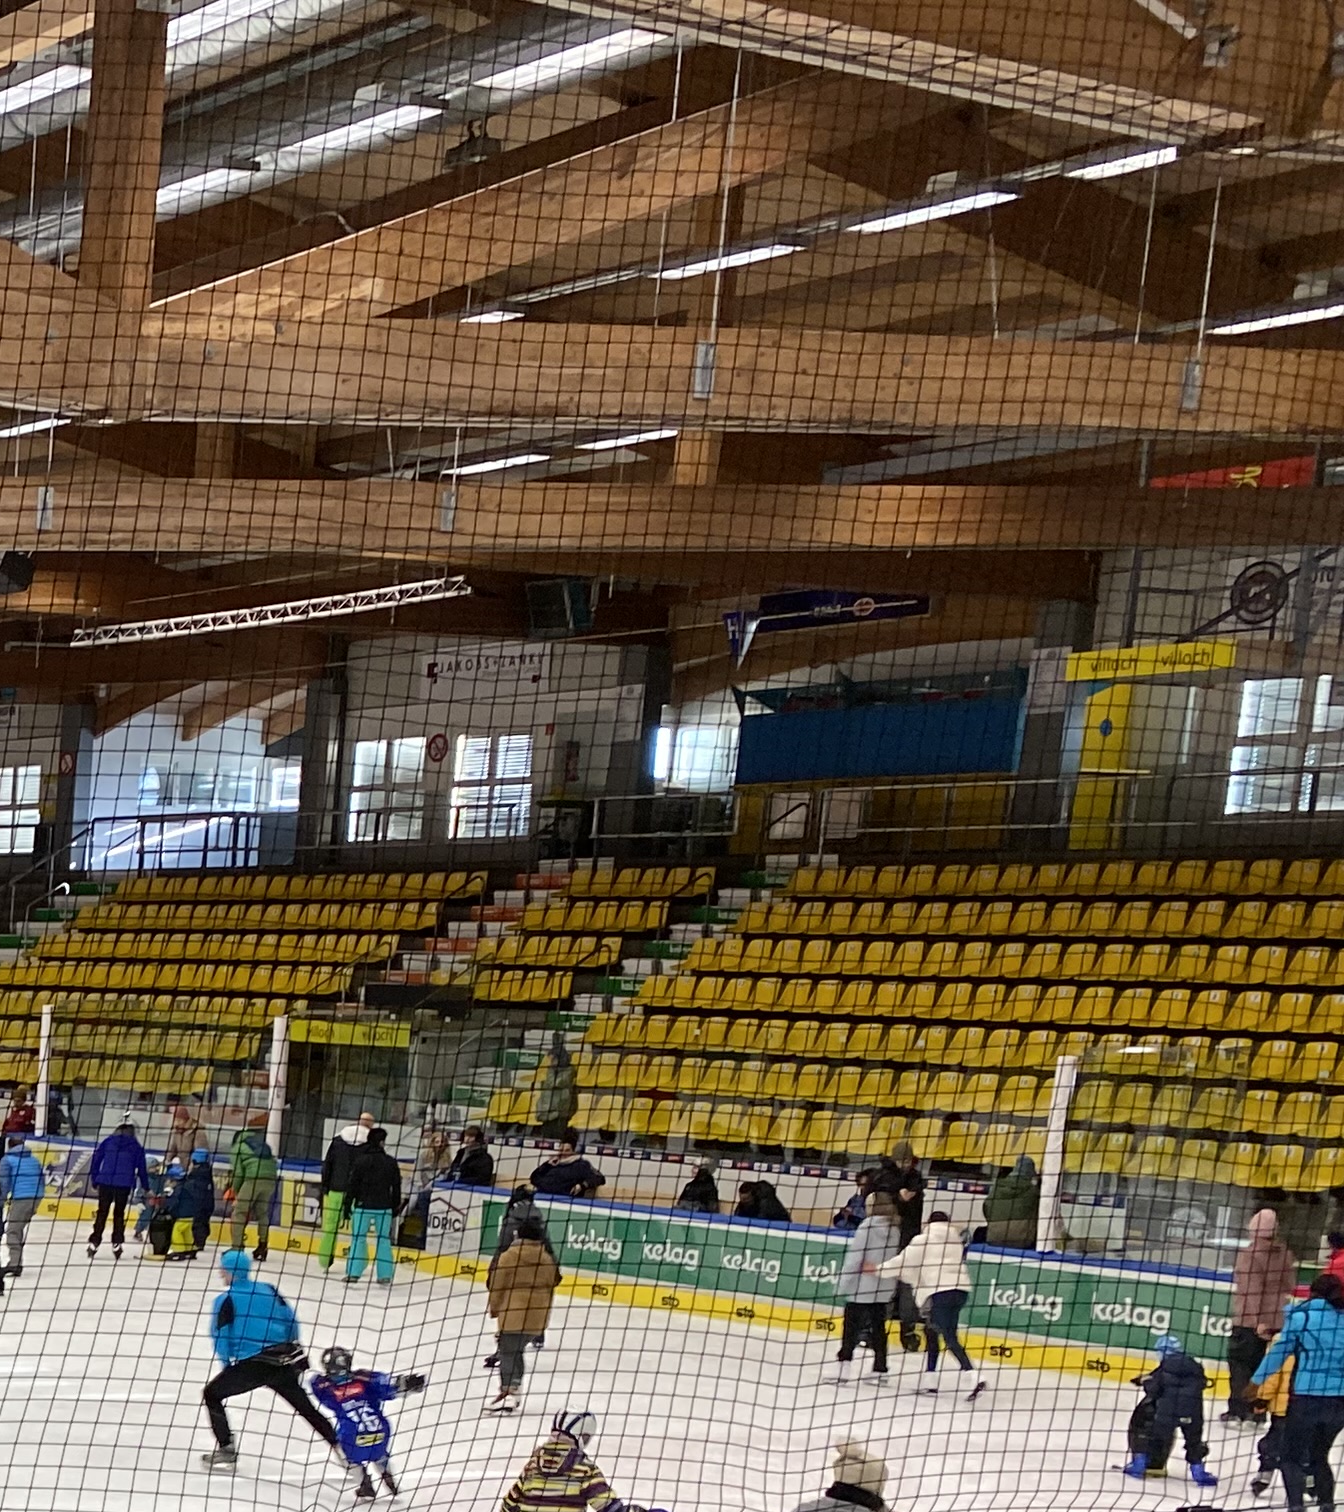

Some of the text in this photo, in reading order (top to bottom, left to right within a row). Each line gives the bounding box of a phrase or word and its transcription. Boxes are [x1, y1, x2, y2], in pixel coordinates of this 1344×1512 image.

[1090, 648, 1211, 673] villach villach
[567, 1224, 623, 1261] kelag
[642, 1233, 700, 1272] kelag
[721, 1246, 781, 1283] kelag
[803, 1254, 839, 1285] kel
[988, 1278, 1064, 1322] kelag
[1091, 1289, 1171, 1335] kelag
[989, 1344, 1013, 1359] sto
[1086, 1357, 1111, 1373] sto
